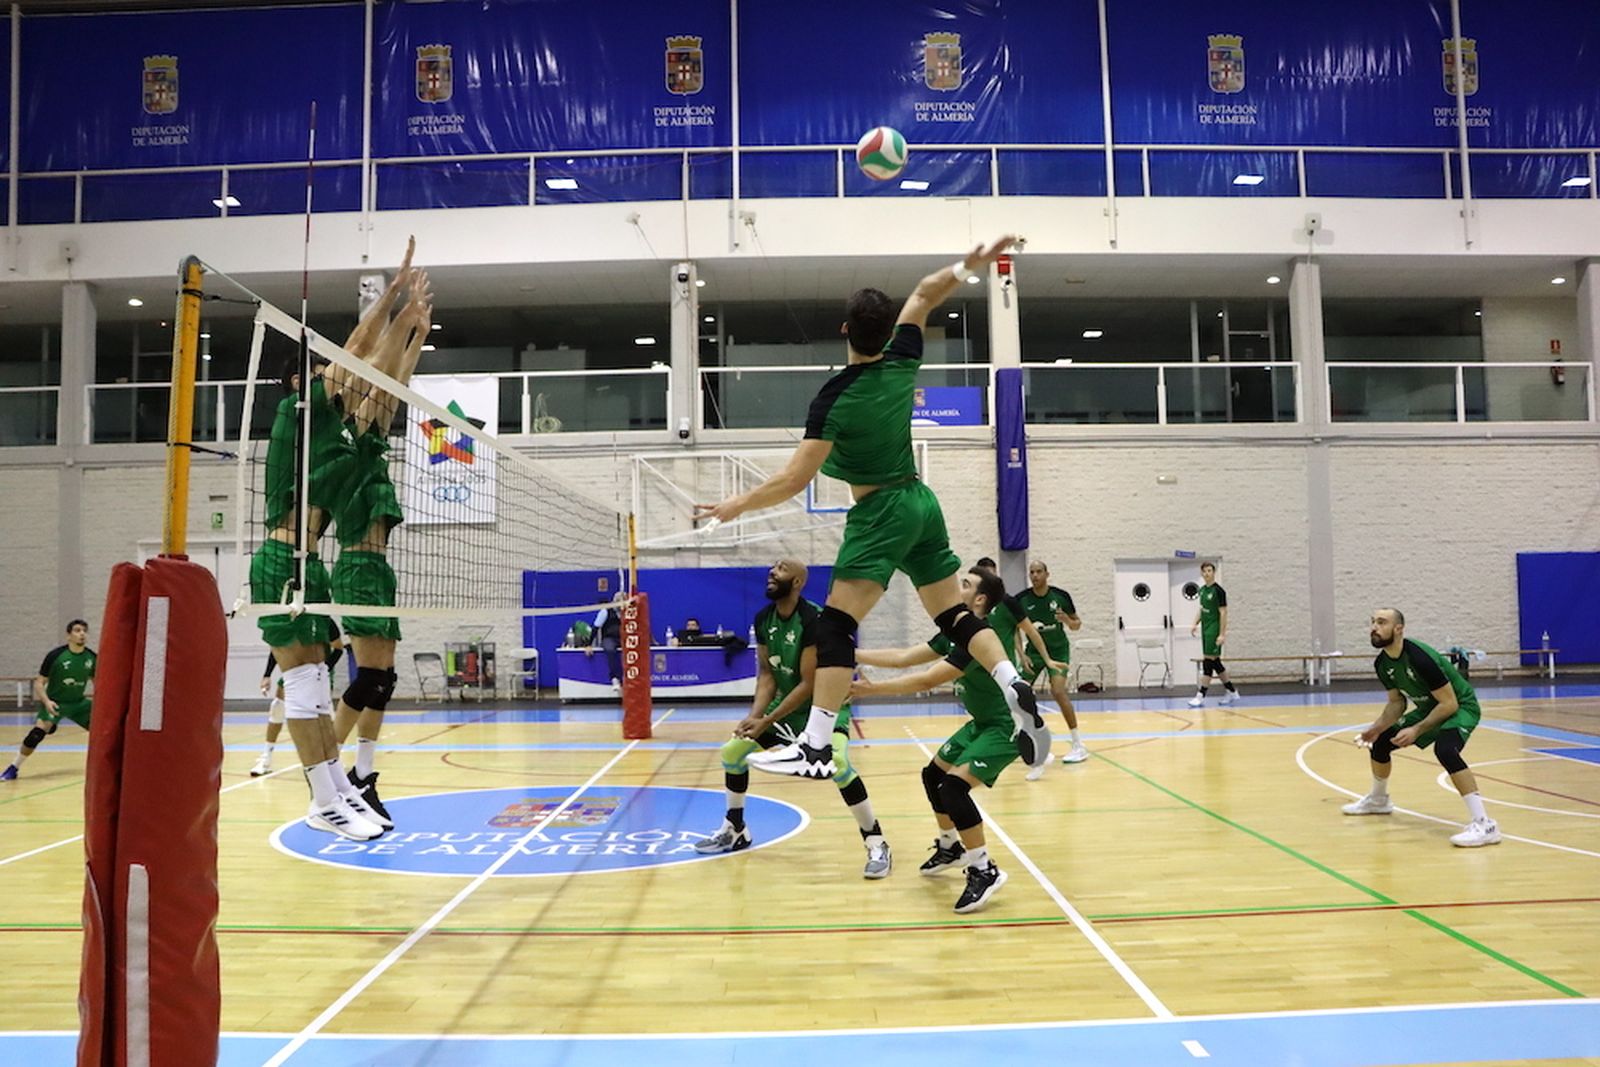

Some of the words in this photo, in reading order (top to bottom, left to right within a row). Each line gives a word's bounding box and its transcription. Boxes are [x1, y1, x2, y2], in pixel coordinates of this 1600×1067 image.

[654, 104, 715, 116] DIPUTACIÓN
[915, 101, 975, 111] DIPUTACIÓN
[1199, 104, 1257, 114] DIPUTACIÓN
[916, 112, 929, 121] DE
[931, 112, 974, 121] ALMERÍA
[1434, 106, 1491, 117] DIPUCIÓN
[655, 117, 668, 126] DE
[671, 116, 714, 126] ALMERÍA
[1200, 115, 1212, 124] DE
[1215, 115, 1256, 124] ALMERÍA
[1435, 118, 1447, 127] DE
[131, 125, 189, 136] DIPUTACIÓN
[408, 127, 420, 136] DE
[421, 125, 464, 135] ALMERÍA
[133, 137, 145, 146] DE
[921, 409, 930, 417] DE
[318, 843, 404, 855] DE
